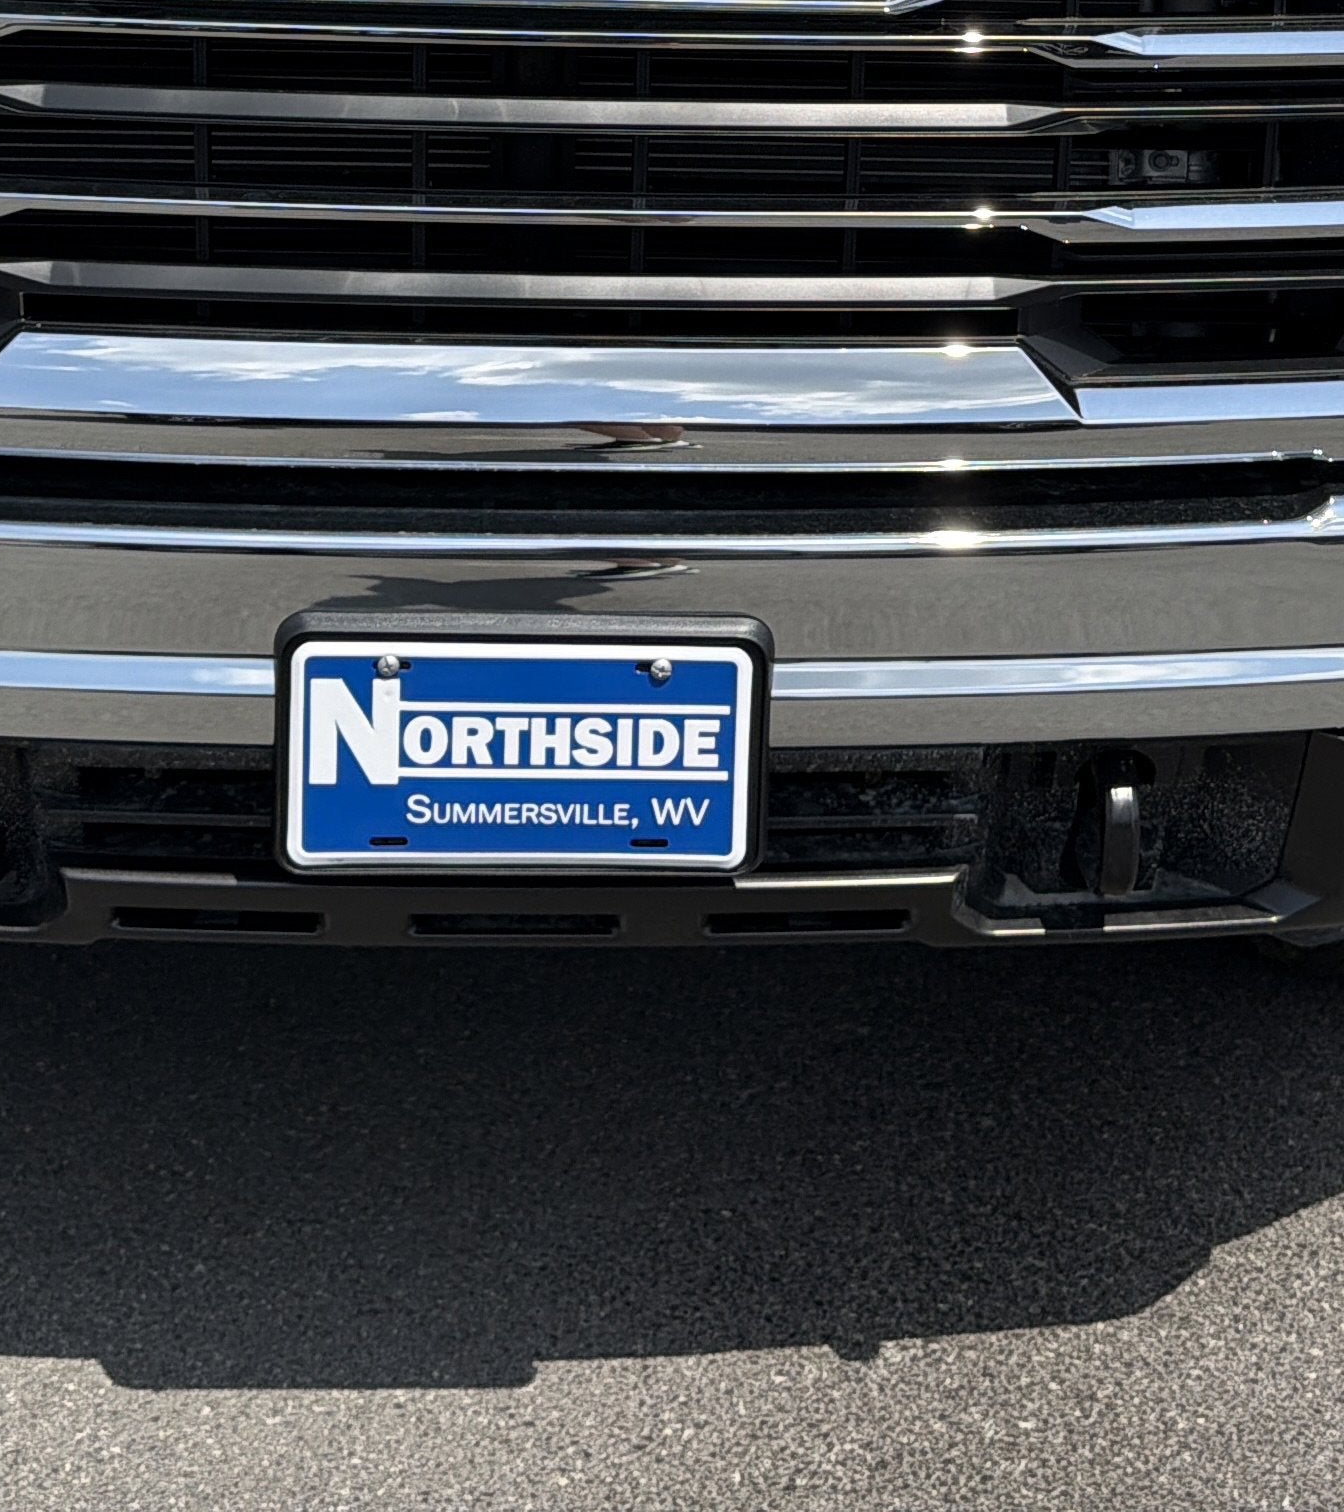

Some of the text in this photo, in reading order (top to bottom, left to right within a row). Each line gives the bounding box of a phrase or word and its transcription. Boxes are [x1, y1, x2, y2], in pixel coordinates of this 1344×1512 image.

[308, 677, 721, 786] NORTHSIDE
[404, 794, 711, 831] SUMMERSVILLE, WV
